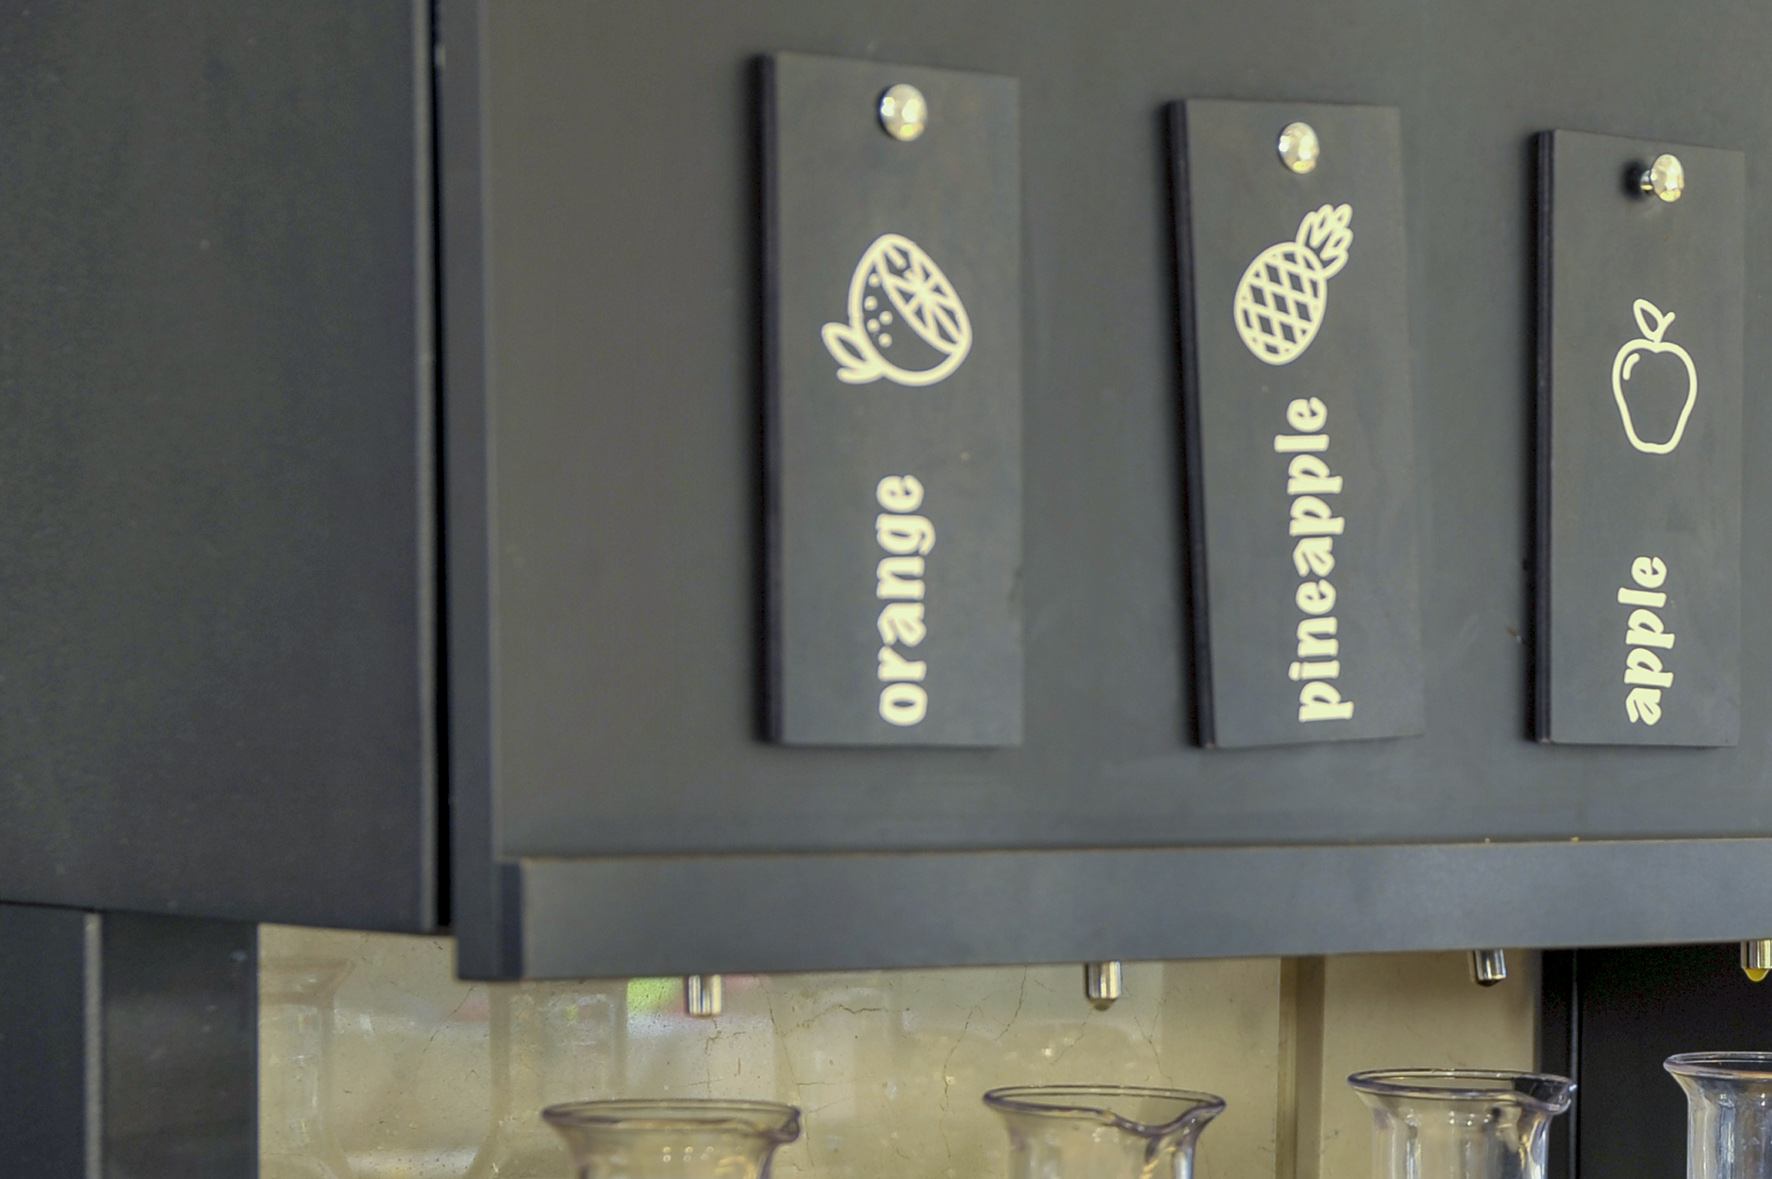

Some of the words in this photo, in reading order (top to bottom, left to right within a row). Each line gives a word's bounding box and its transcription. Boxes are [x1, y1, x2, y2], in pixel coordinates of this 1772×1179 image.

[874, 474, 937, 727] orange
[1273, 396, 1355, 723] pineapple
[1617, 556, 1676, 726] apple
